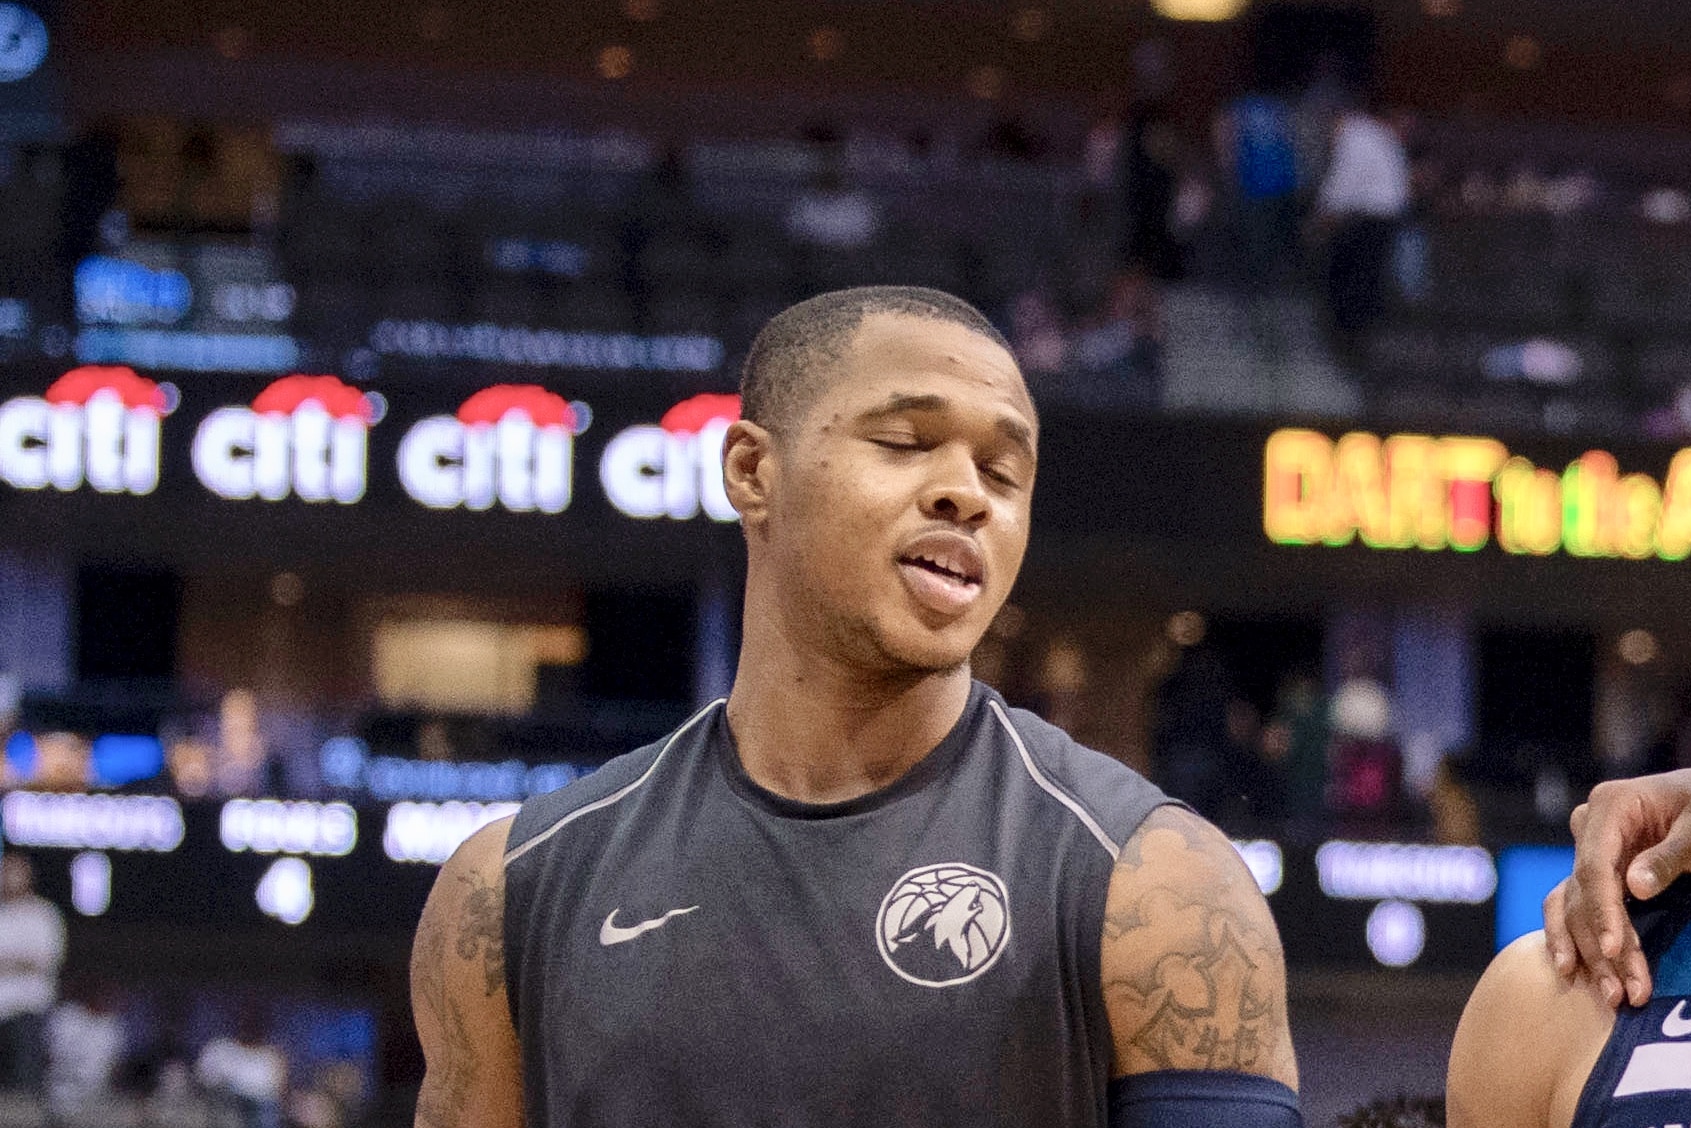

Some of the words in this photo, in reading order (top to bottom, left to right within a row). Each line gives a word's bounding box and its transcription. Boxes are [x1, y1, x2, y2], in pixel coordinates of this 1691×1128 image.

[0, 386, 161, 495] citi
[191, 397, 368, 504] citi
[397, 408, 574, 514] citi
[602, 416, 741, 523] cit
